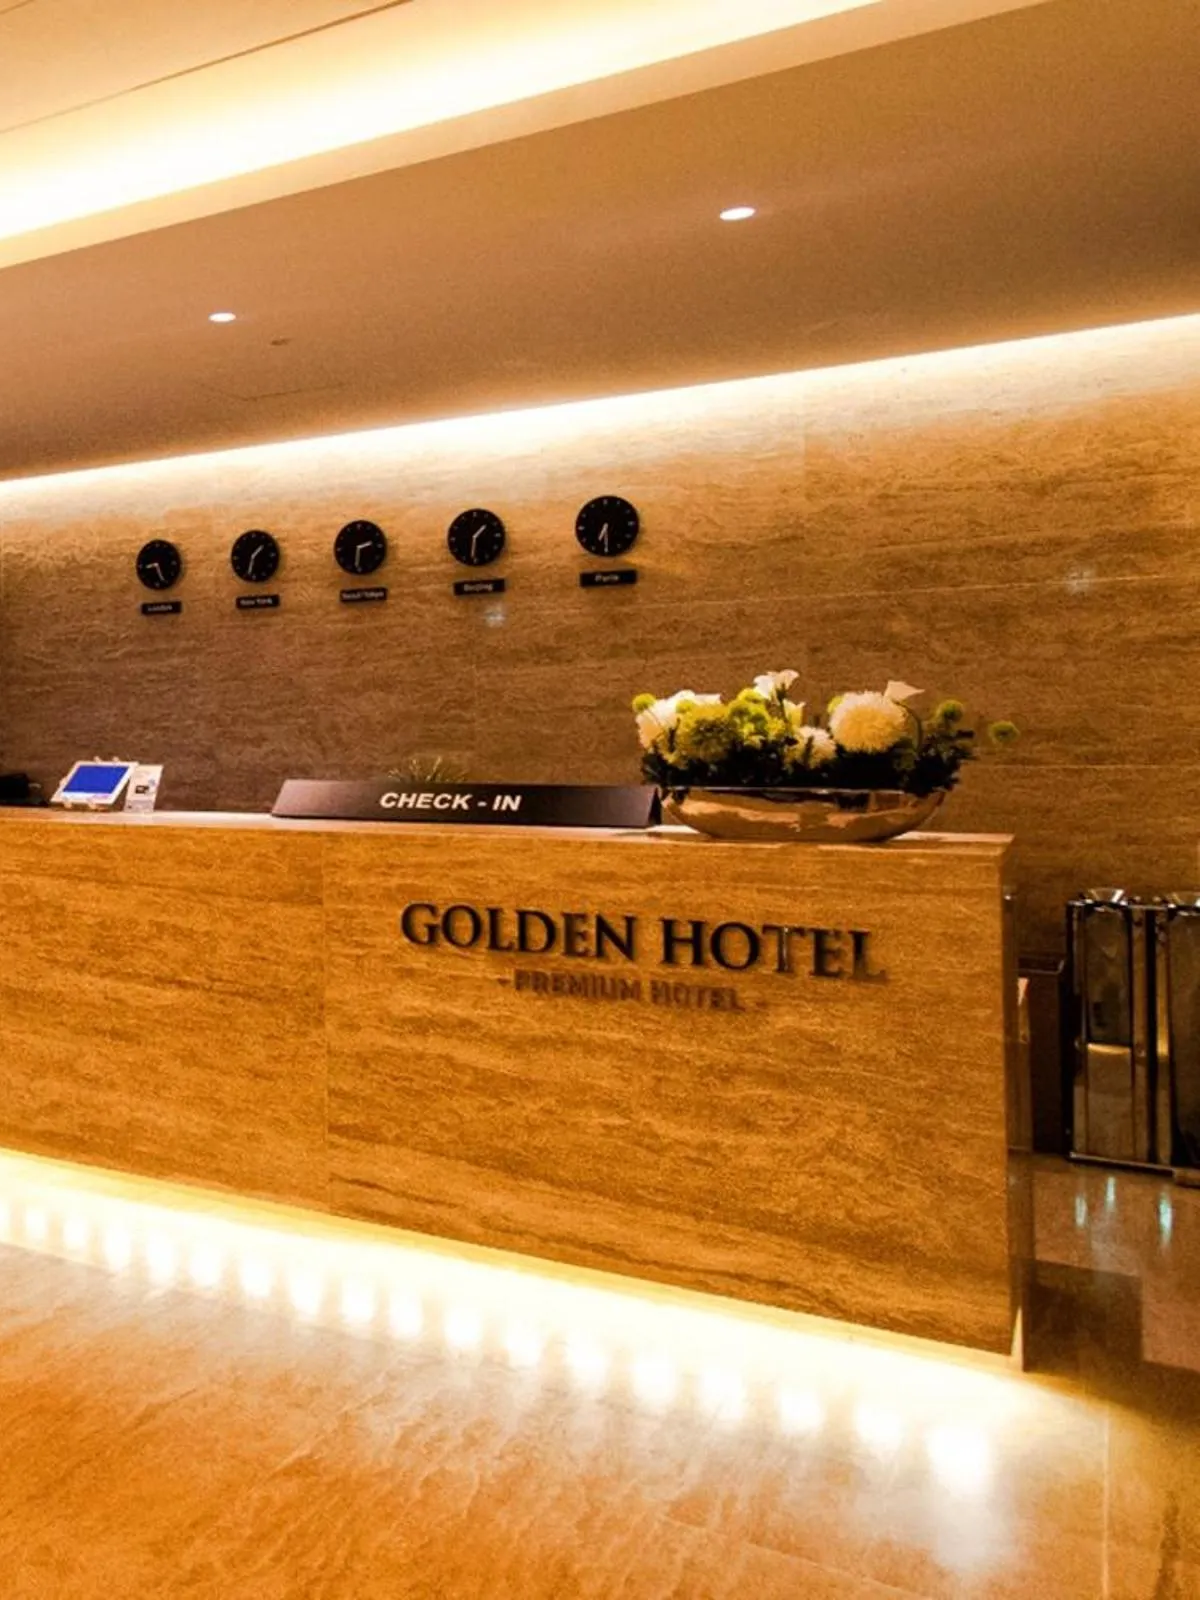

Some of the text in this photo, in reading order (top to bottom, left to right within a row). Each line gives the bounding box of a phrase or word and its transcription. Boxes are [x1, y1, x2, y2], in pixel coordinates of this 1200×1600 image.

[379, 791, 474, 812] CHECK
[491, 794, 522, 812] IN
[400, 902, 889, 984] GOLDEN HOTEL
[513, 968, 747, 1013] PREMIUM HOTEL
